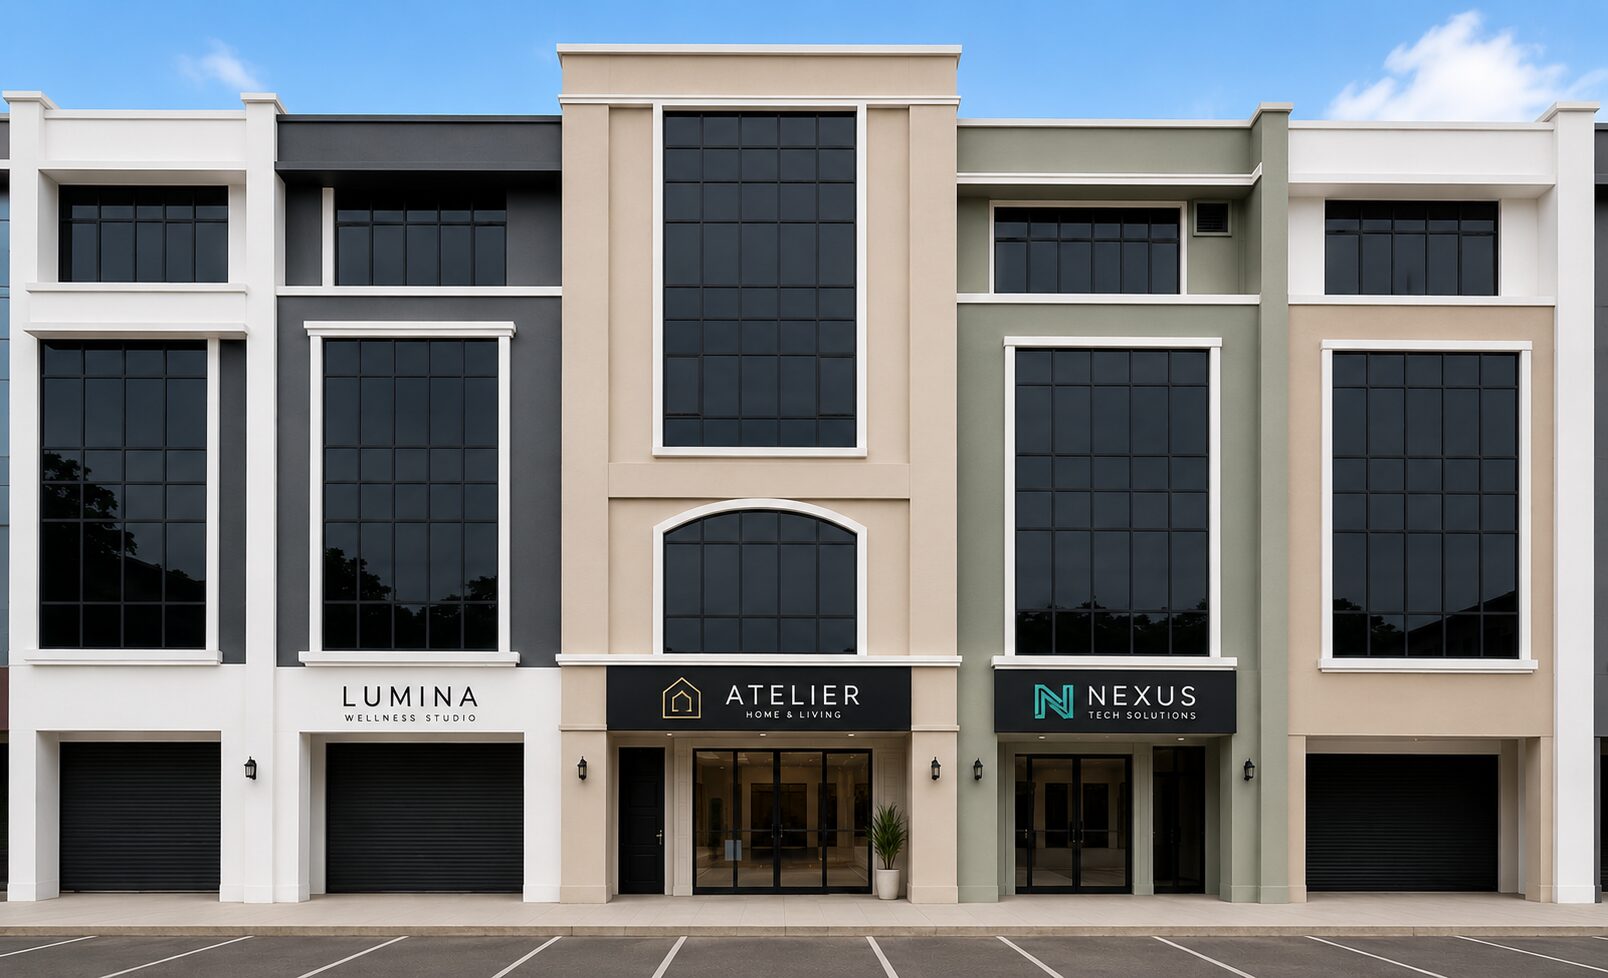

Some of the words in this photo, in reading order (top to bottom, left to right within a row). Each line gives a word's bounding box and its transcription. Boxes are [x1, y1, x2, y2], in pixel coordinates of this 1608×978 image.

[343, 685, 478, 708] LUMINA
[725, 684, 861, 706] ATELIER
[1088, 685, 1197, 707] NEXUS
[344, 713, 416, 722] WELLNESS
[425, 713, 477, 722] STUDIO
[745, 710, 780, 719] HOME
[786, 710, 793, 719] &
[799, 710, 841, 719] LIVING
[1088, 710, 1120, 720] TECH
[1126, 710, 1197, 720] SOLUTIONS
